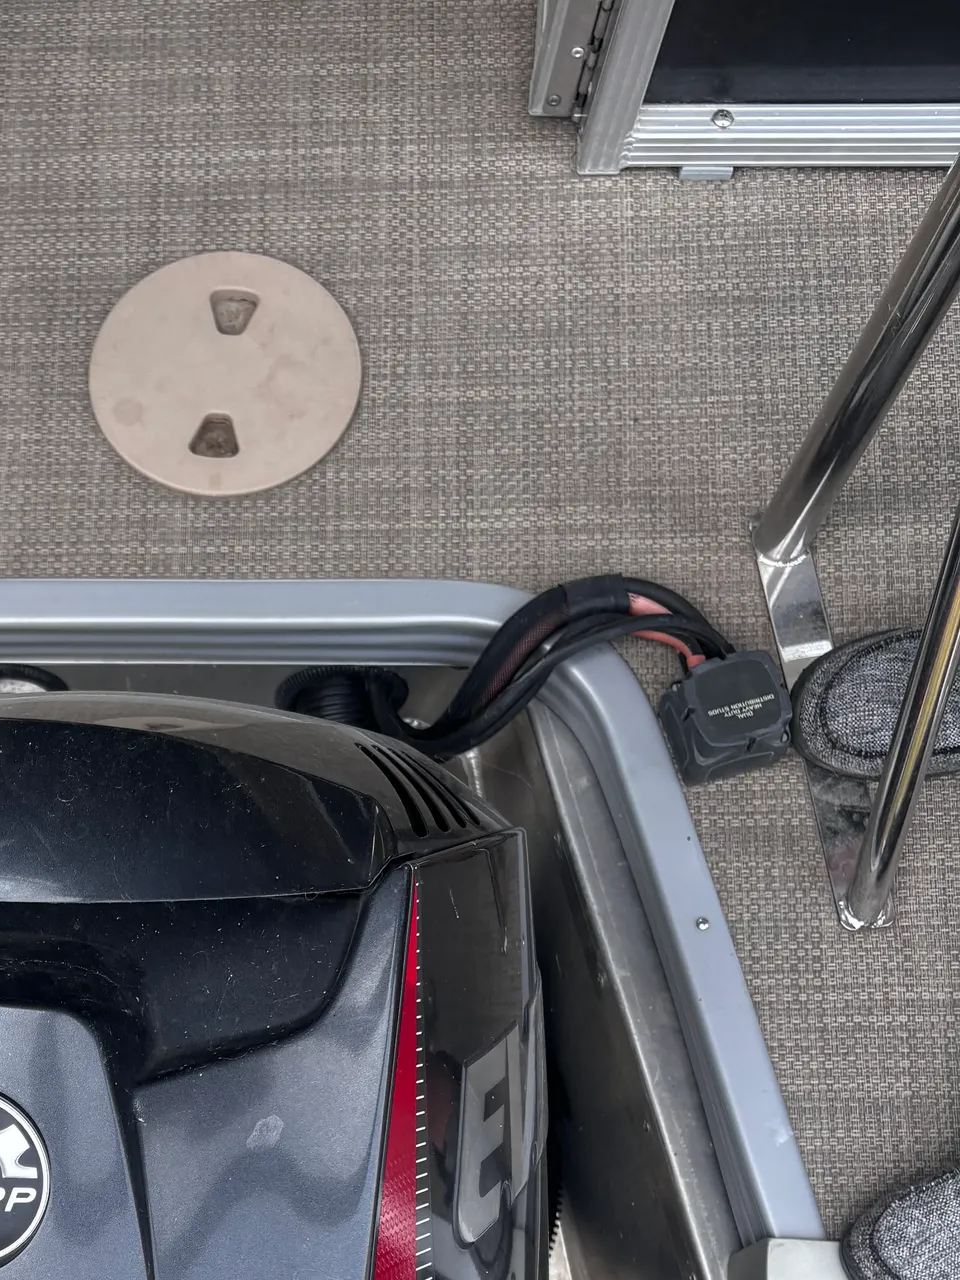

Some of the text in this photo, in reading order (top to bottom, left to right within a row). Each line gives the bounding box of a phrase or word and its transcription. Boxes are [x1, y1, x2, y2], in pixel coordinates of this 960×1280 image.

[707, 693, 775, 716] DISTRIBUTION STUDS
[724, 703, 763, 718] HEAVY DUTY
[736, 710, 754, 719] DUAL
